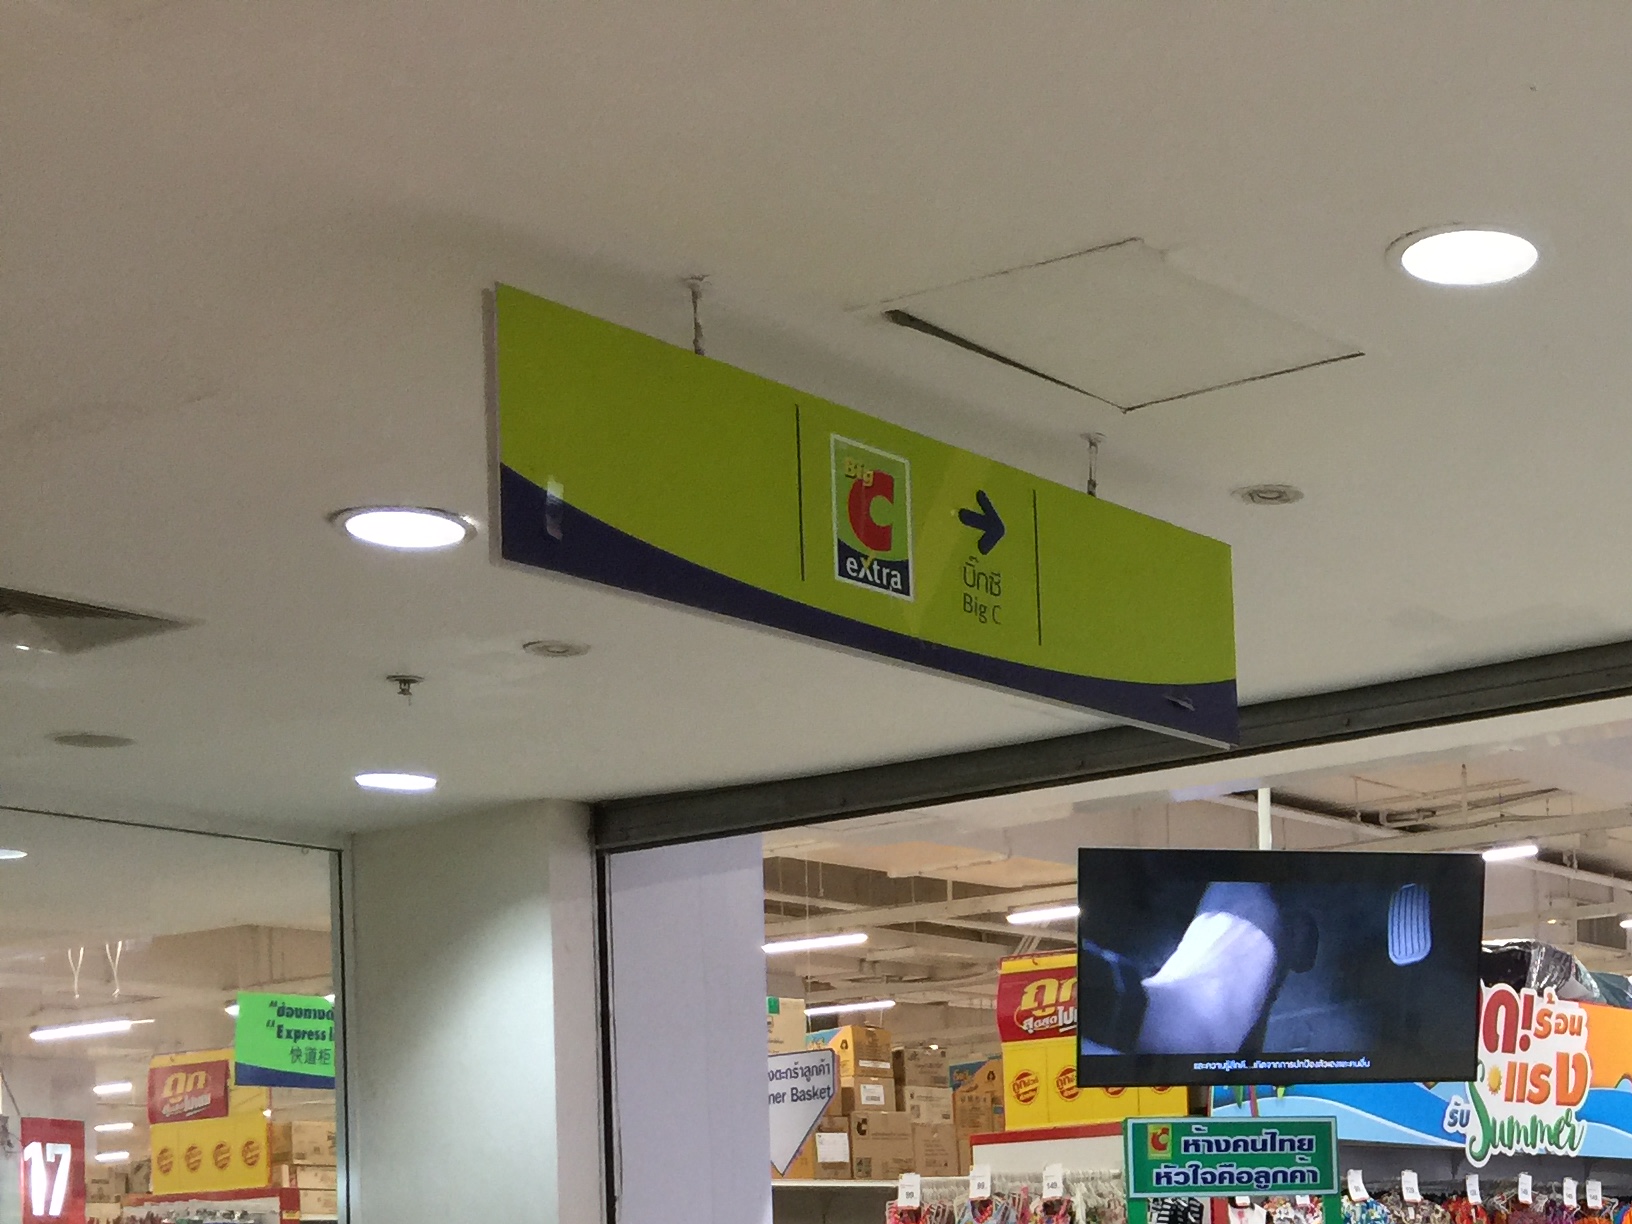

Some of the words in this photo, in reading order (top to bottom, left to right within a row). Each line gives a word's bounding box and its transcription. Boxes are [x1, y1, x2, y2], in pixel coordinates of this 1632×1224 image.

[848, 469, 895, 552] C
[962, 592, 989, 625] Big
[790, 1085, 831, 1102] Basket
[1181, 1124, 1316, 1154] ห้างคนไทย
[23, 1141, 72, 1216] 17
[1153, 1155, 1319, 1189] หัวใจคือลูกค้า
